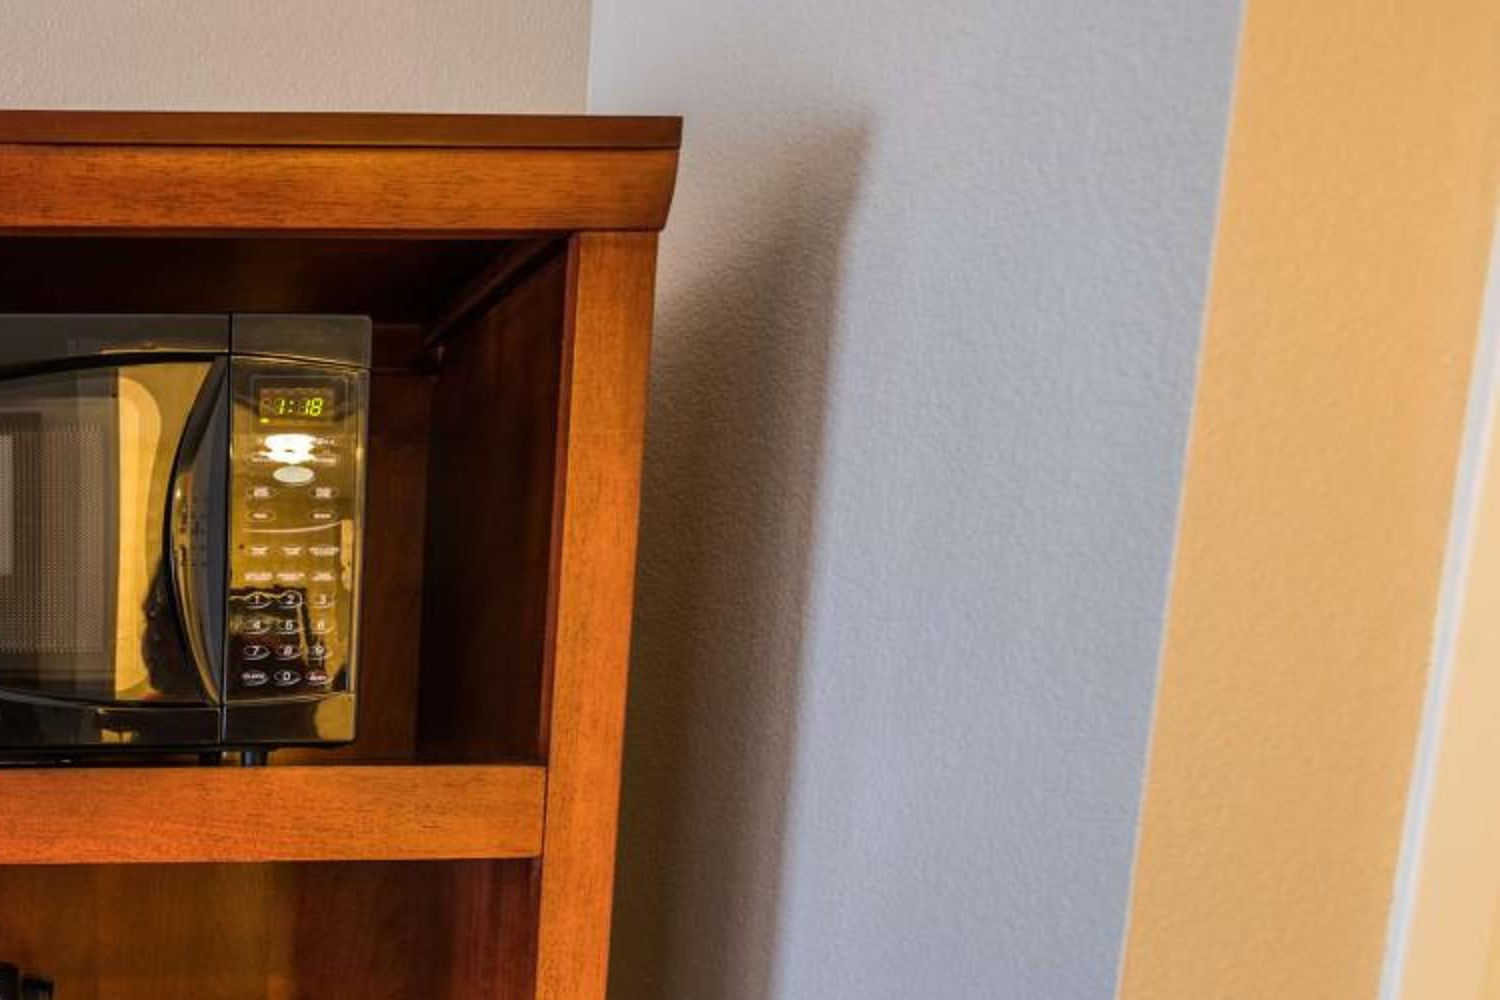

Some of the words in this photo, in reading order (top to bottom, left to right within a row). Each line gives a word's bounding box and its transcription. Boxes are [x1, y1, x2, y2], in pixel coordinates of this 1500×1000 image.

[279, 397, 323, 416] 1:18
[285, 594, 295, 604] 2
[252, 620, 261, 629] 4
[252, 646, 260, 655] 7
[282, 672, 291, 681] 0
